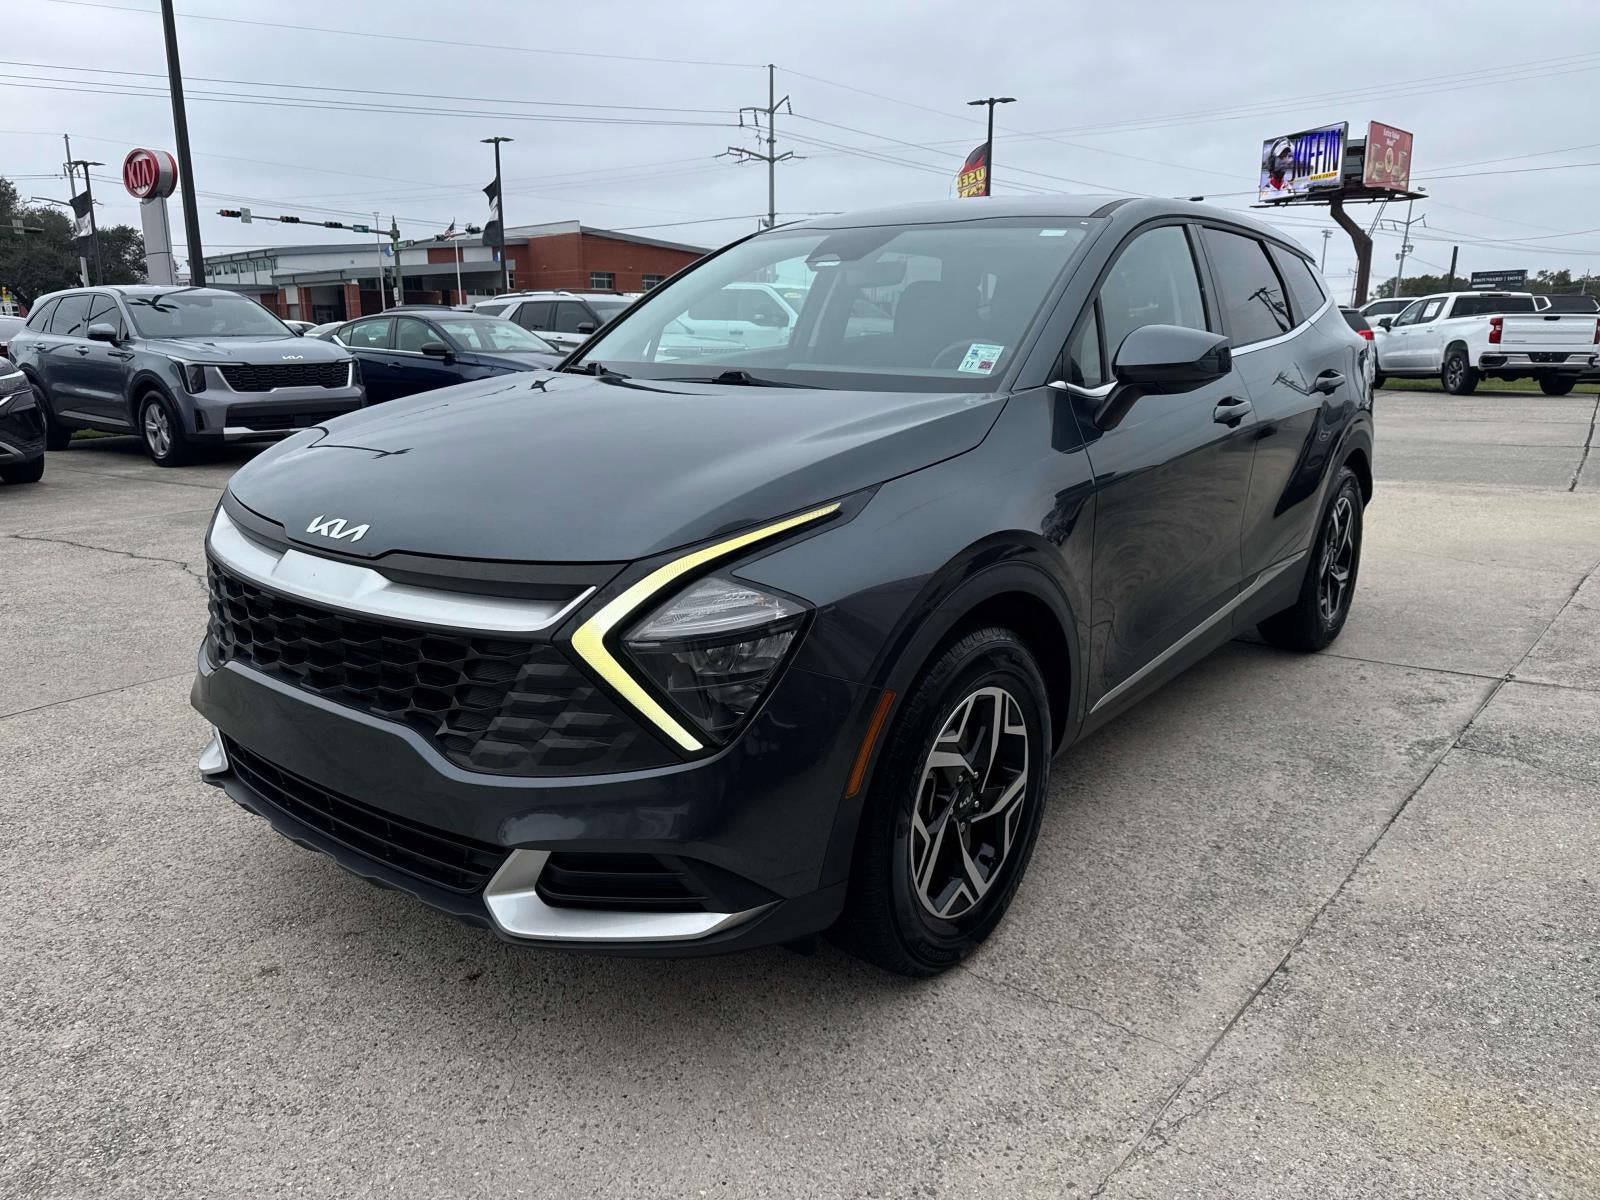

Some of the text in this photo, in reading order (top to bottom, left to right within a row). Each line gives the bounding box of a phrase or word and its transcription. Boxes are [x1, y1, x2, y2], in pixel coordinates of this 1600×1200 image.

[1292, 129, 1341, 180] KIFFIN
[127, 159, 151, 189] KIA
[306, 514, 370, 543] KIA
